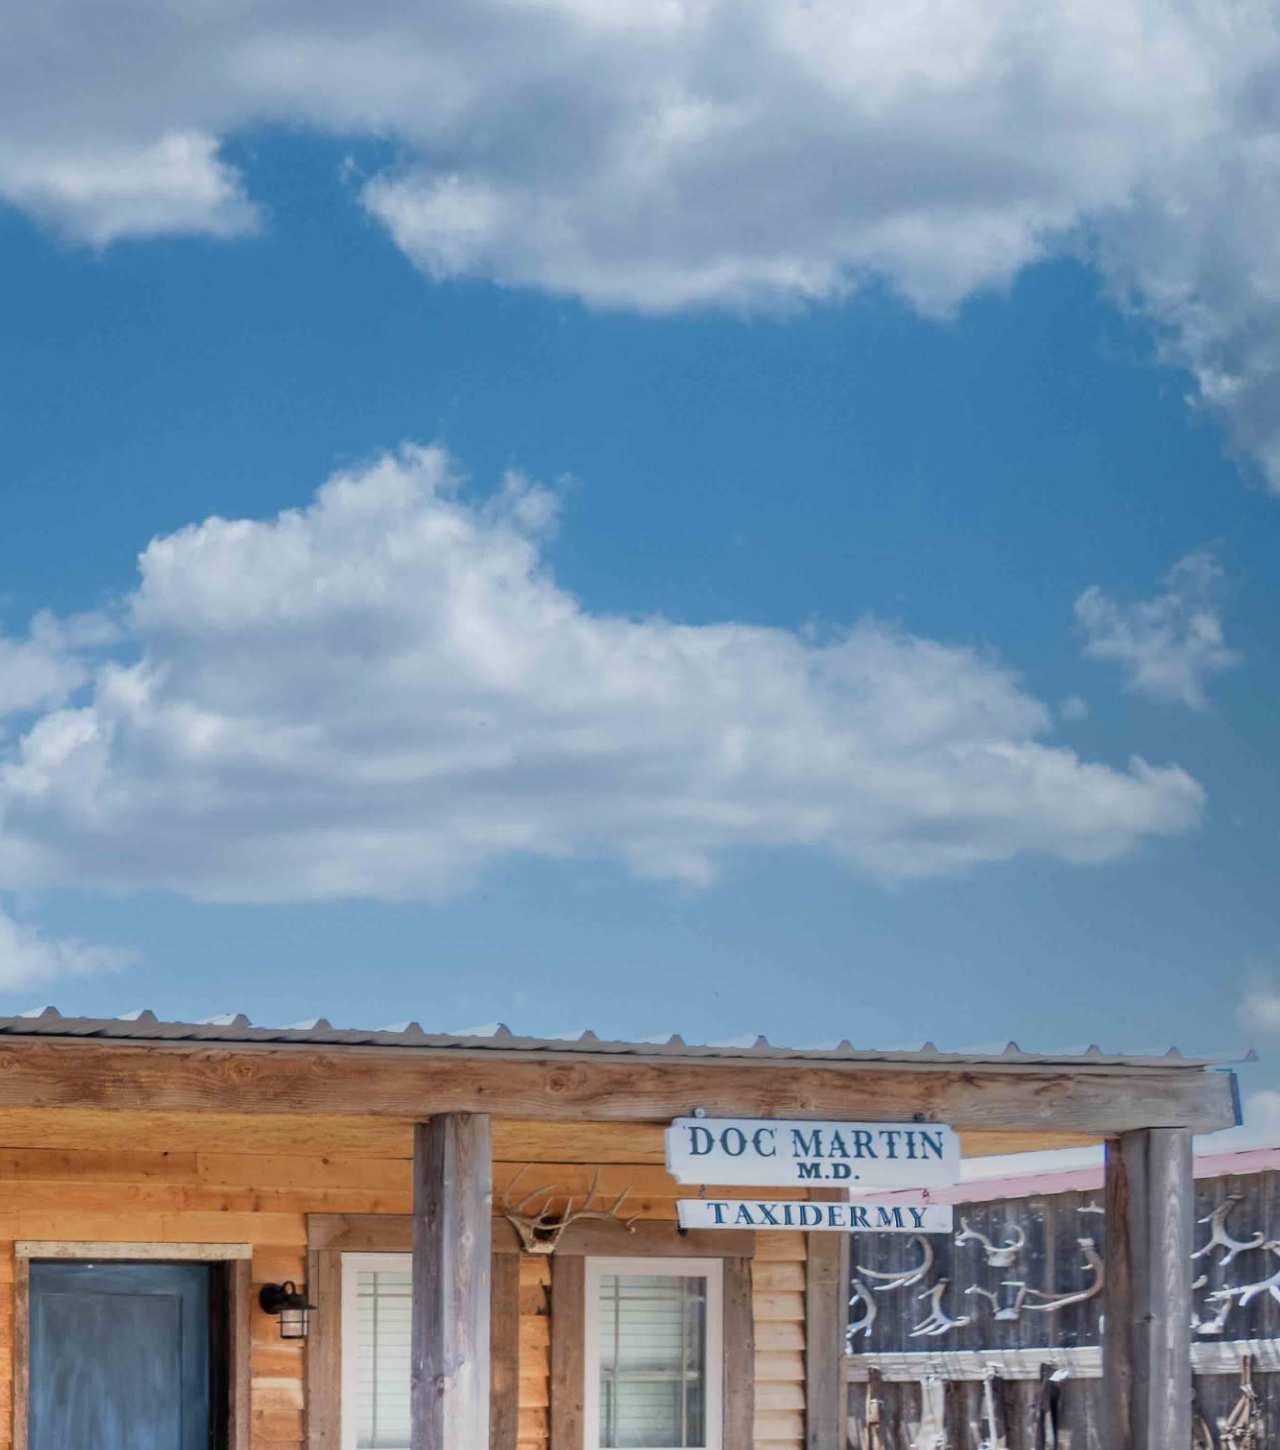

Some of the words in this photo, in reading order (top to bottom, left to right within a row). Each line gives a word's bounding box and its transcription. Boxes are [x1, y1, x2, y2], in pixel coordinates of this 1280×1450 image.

[790, 1128, 944, 1160] MARTIN
[797, 1163, 861, 1180] M.D.
[706, 1202, 929, 1230] TAXIDERMY
